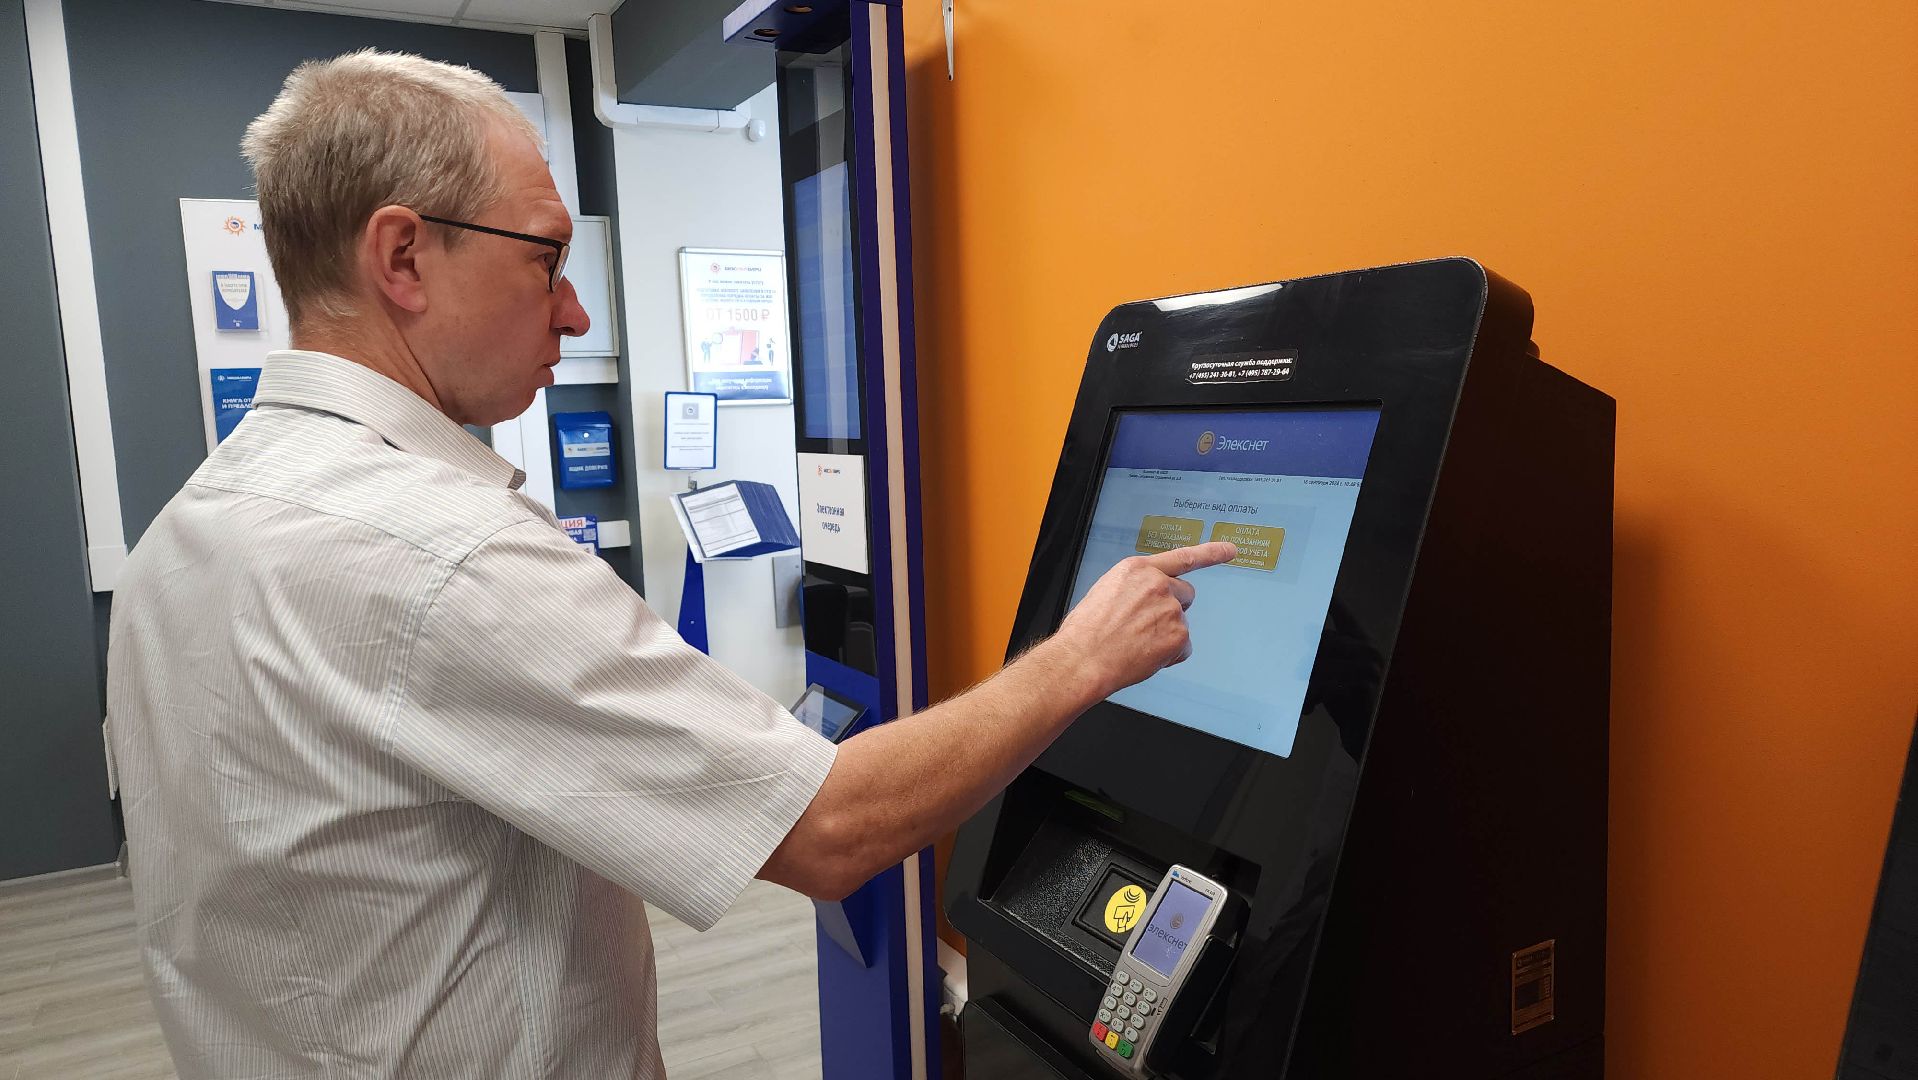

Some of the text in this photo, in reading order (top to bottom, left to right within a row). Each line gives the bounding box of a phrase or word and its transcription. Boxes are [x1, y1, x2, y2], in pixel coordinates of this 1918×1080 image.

[705, 308, 722, 321] ОТ
[728, 308, 758, 321] 1500
[1118, 332, 1140, 343] SAGA
[1191, 362, 1234, 370] Круглосуточная
[1234, 359, 1256, 368] служба
[1216, 435, 1270, 451] Элекснет
[1173, 498, 1259, 515] Выберите вид оплаты
[560, 519, 583, 529] ЦИЯ
[1160, 523, 1182, 531] ОПЛАТА
[1235, 527, 1260, 536] ОПЛАТА
[1230, 536, 1271, 548] ПОКАЗАНИЯМ
[1248, 549, 1268, 558] УЧЕТА
[1147, 923, 1189, 952] элекснет
